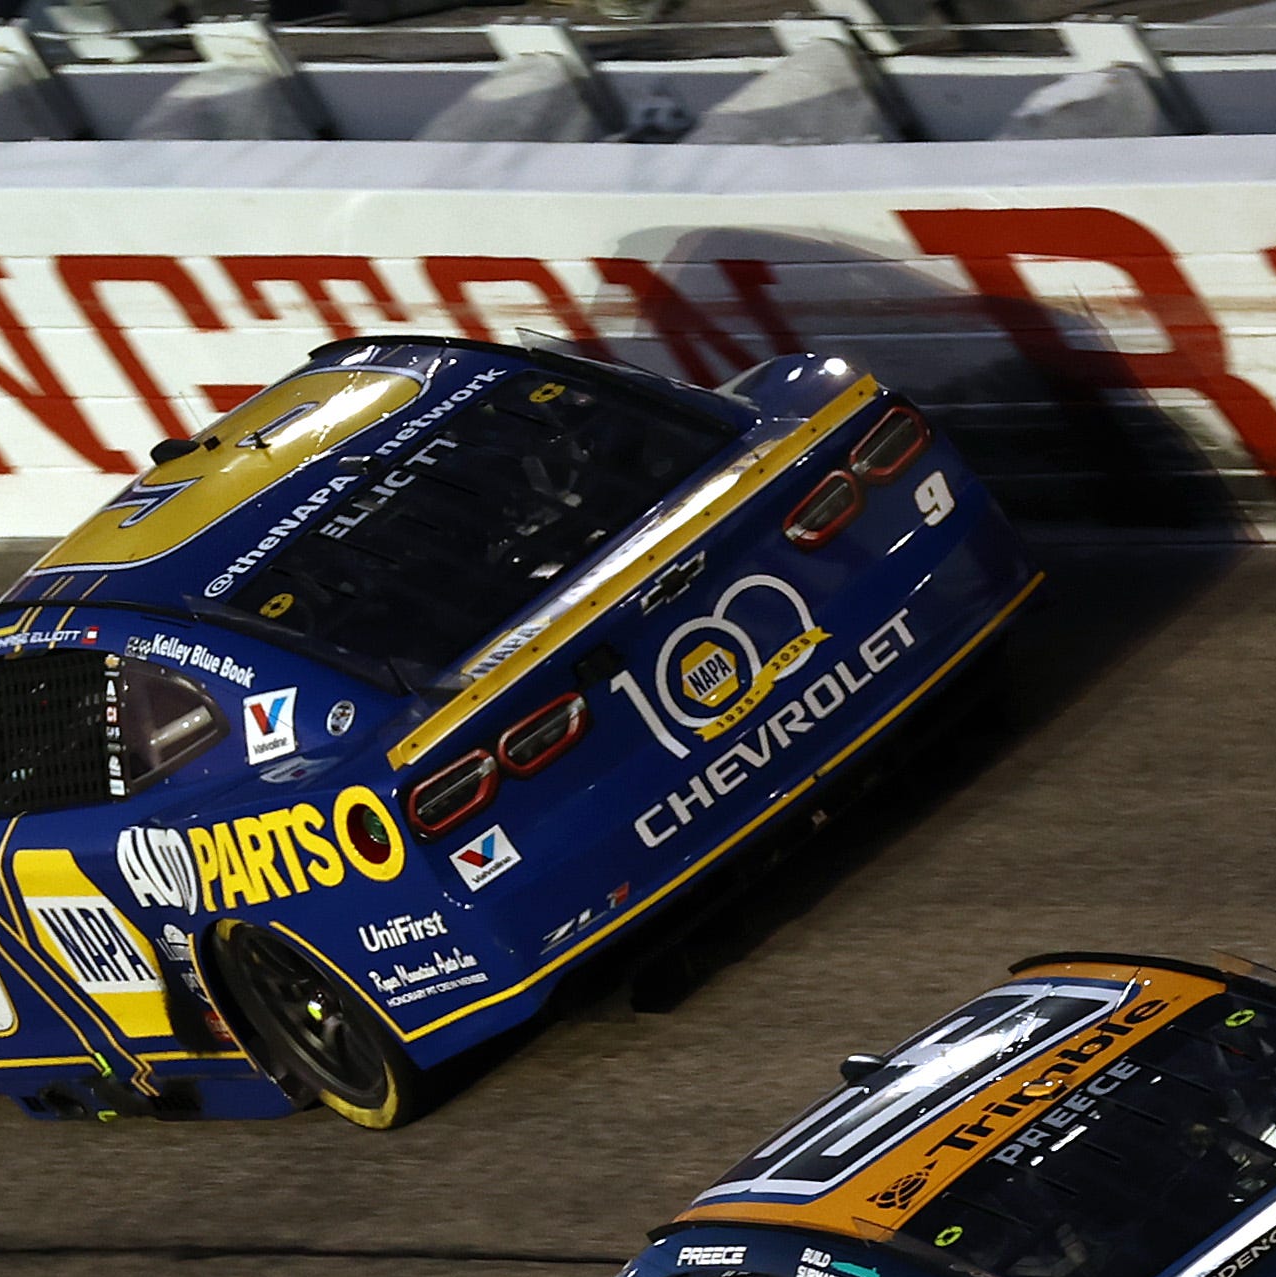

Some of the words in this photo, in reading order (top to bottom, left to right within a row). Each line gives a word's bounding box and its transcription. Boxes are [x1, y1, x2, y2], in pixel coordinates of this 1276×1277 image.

[376, 366, 507, 458] network
[914, 470, 955, 527] 9
[30, 630, 82, 644] ELLIOTT
[151, 632, 192, 666] Kelley
[190, 645, 221, 674] Blue
[219, 656, 256, 689] Book
[687, 653, 733, 697] NAPA
[253, 735, 289, 755] Valvoline
[634, 607, 918, 849] CHEVROLET
[188, 801, 346, 913] PARTS
[38, 906, 157, 983] NAPA
[358, 910, 448, 953] UniFirst
[925, 997, 1169, 1156] Trimble
[994, 1055, 1141, 1167] PREECE
[678, 1245, 747, 1267] PREECE
[800, 1247, 831, 1268] BUILD
